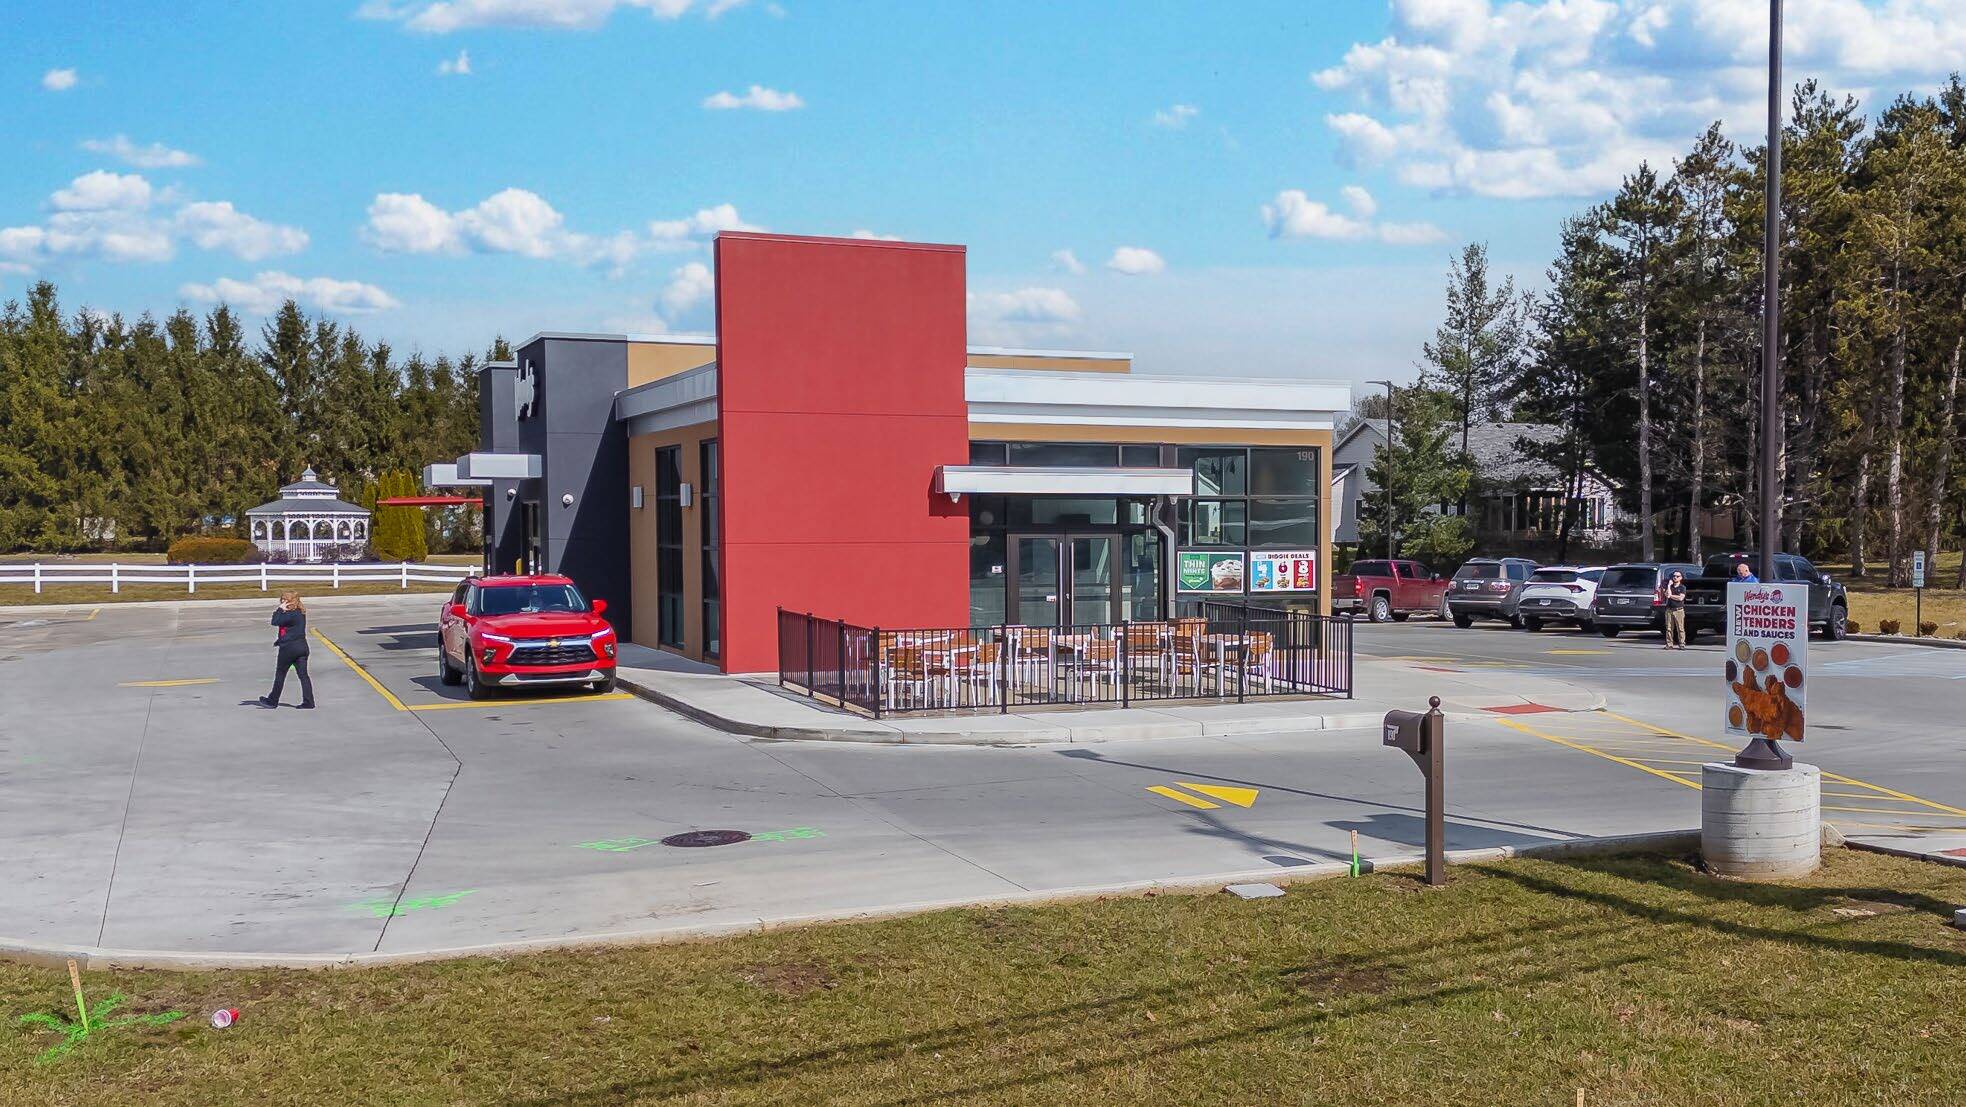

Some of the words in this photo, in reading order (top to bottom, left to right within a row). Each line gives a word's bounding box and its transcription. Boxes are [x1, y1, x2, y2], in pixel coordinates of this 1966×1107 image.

[1296, 451, 1315, 461] 190
[1184, 560, 1206, 568] THIN
[1744, 589, 1770, 603] Wendy's
[1744, 604, 1796, 617] CHICKEN
[1743, 617, 1796, 630] TENDERS
[1743, 629, 1760, 637] AND
[1760, 630, 1796, 639] SAUCES
